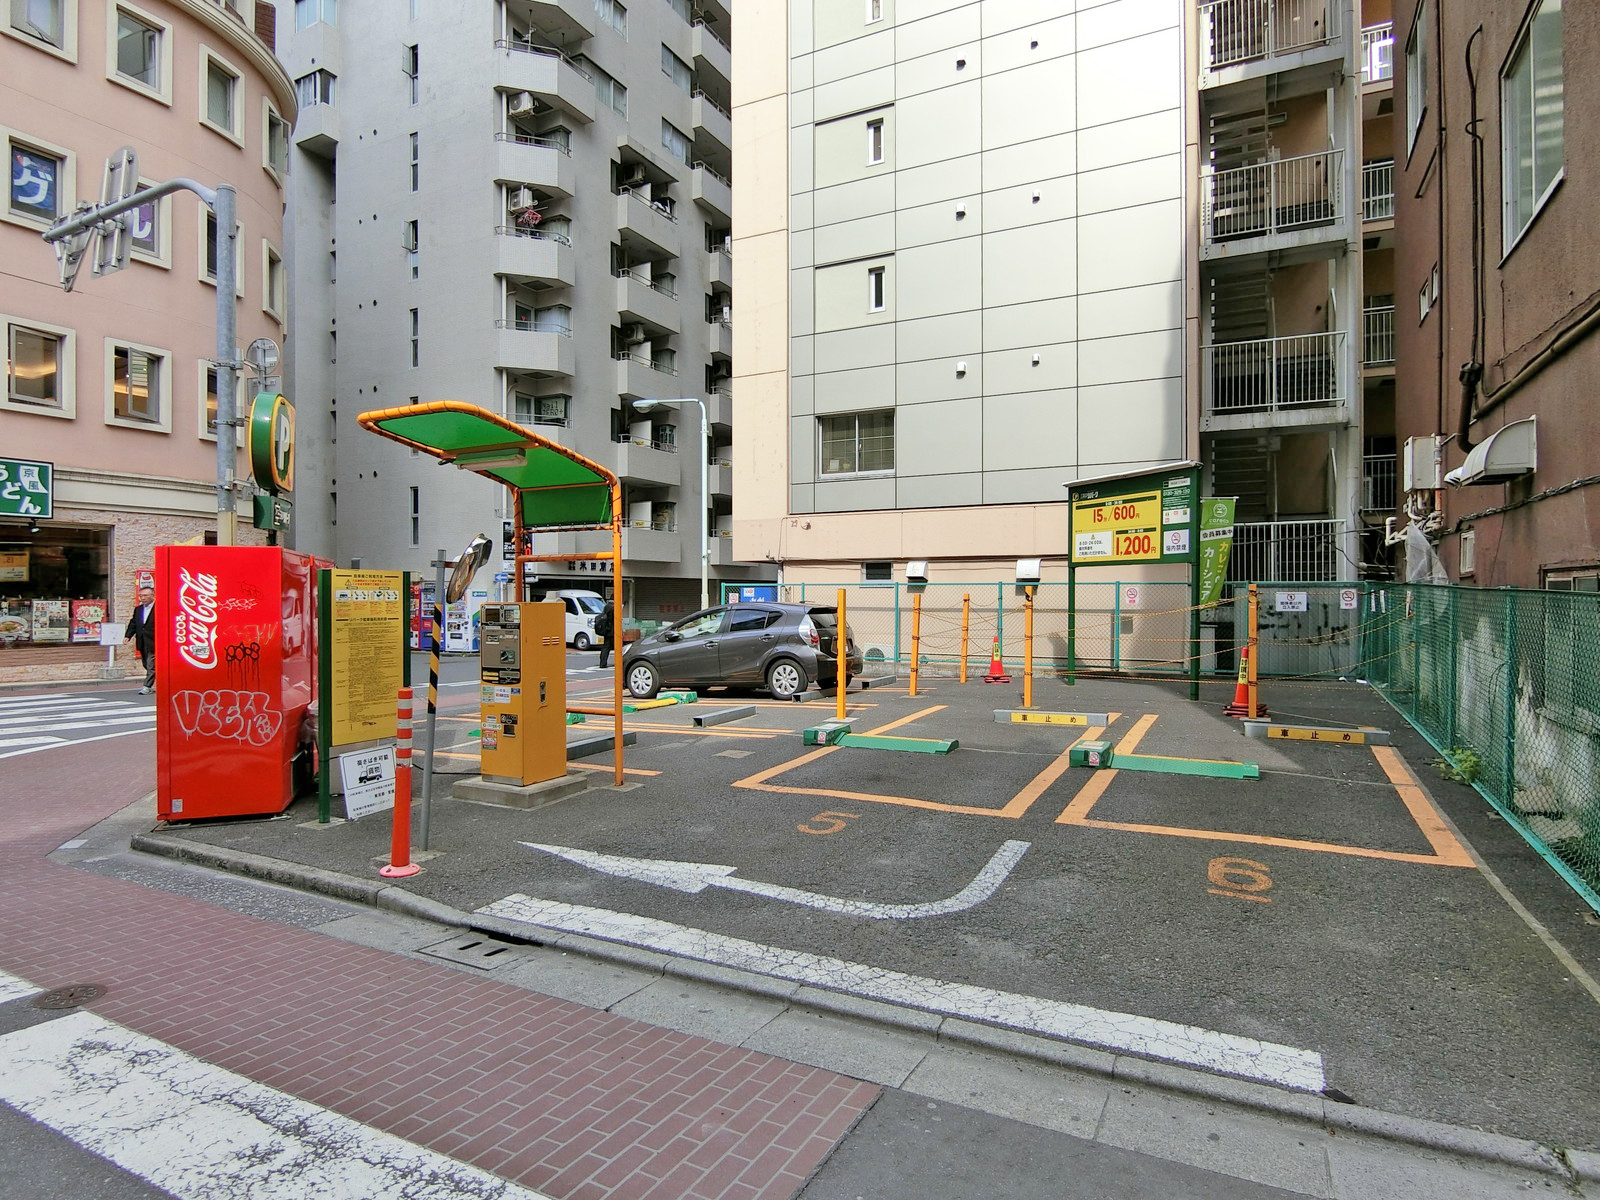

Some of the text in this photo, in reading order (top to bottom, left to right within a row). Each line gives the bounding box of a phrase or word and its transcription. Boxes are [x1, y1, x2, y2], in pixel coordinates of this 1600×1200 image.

[278, 413, 291, 470] P
[23, 467, 40, 491] 京風
[1116, 534, 1157, 556] 1,200円
[1202, 529, 1233, 540] 会員募集中
[1200, 547, 1214, 601] カーシェア
[180, 566, 218, 670] Coca-Cola
[1021, 714, 1077, 723] 車止め
[1280, 728, 1351, 741] 車止め
[356, 753, 389, 767] 荷さばき可能
[368, 766, 381, 775] 貨物
[796, 811, 860, 835] 5
[1207, 857, 1272, 893] 6
